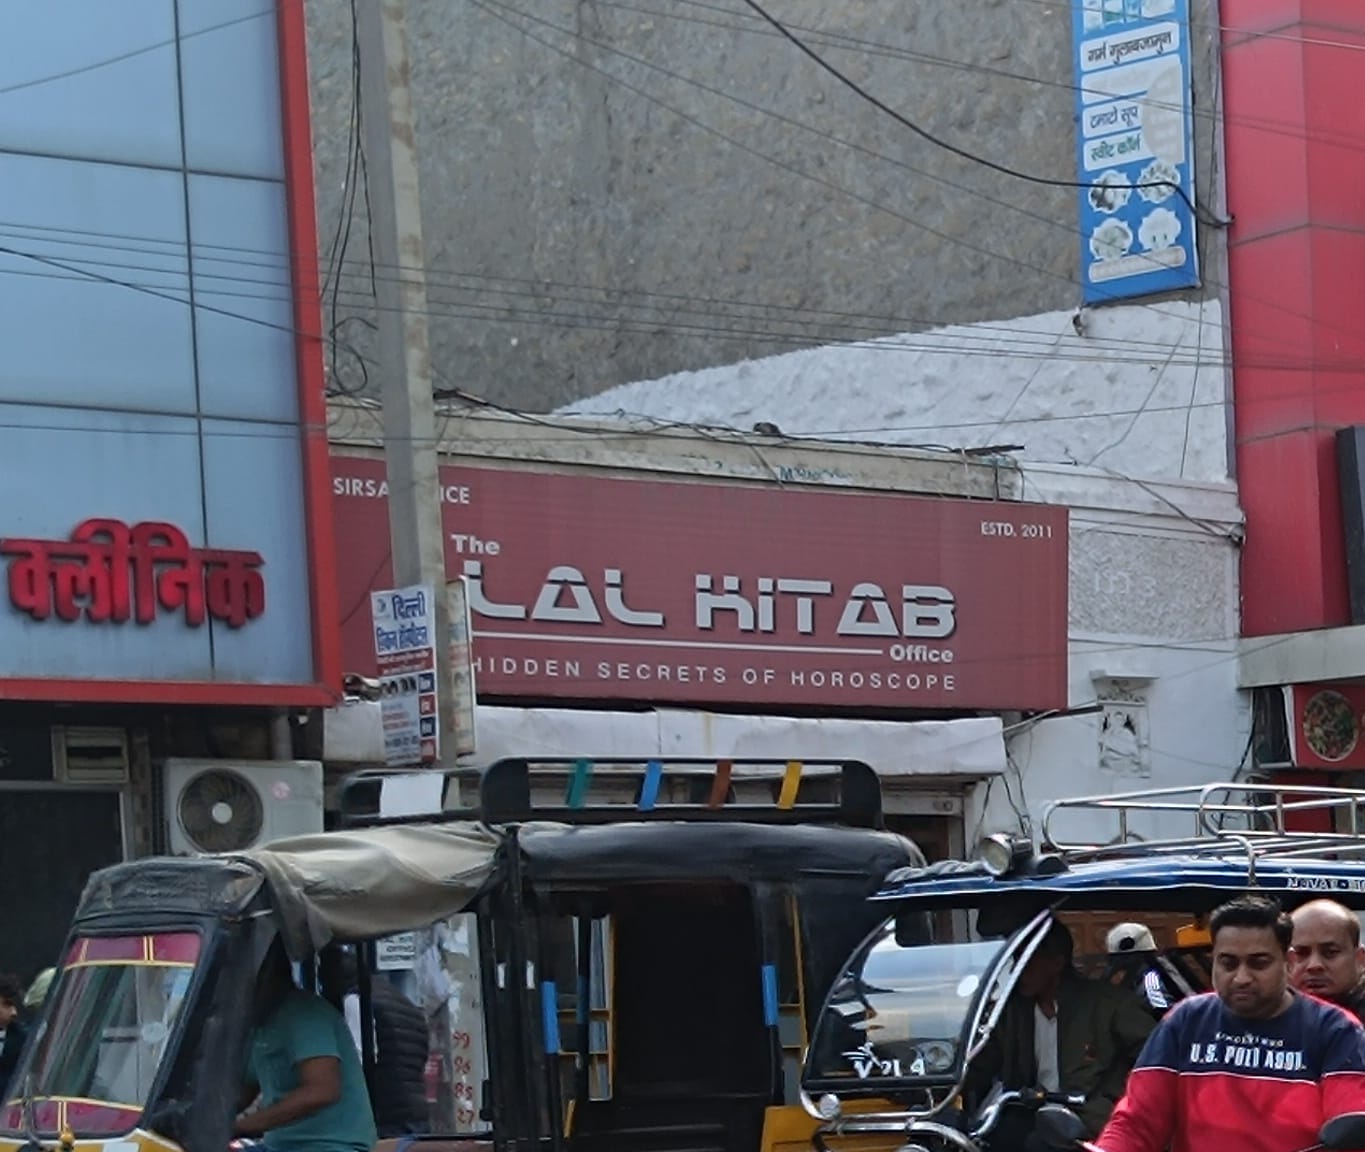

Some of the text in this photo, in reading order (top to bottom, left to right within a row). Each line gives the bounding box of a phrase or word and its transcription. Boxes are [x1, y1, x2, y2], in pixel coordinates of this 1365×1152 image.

[334, 478, 388, 498] SIRSA
[981, 521, 1052, 539] ESTD. 2011
[451, 534, 500, 555] The
[1, 517, 265, 630] क्लीनिक
[464, 560, 956, 639] LAL KITAB
[889, 645, 954, 663] Office
[470, 657, 956, 691] HIDDEN SECRETS OF HOROSCOPE
[1190, 1043, 1219, 1063] U.S.
[1224, 1045, 1260, 1068] POLO
